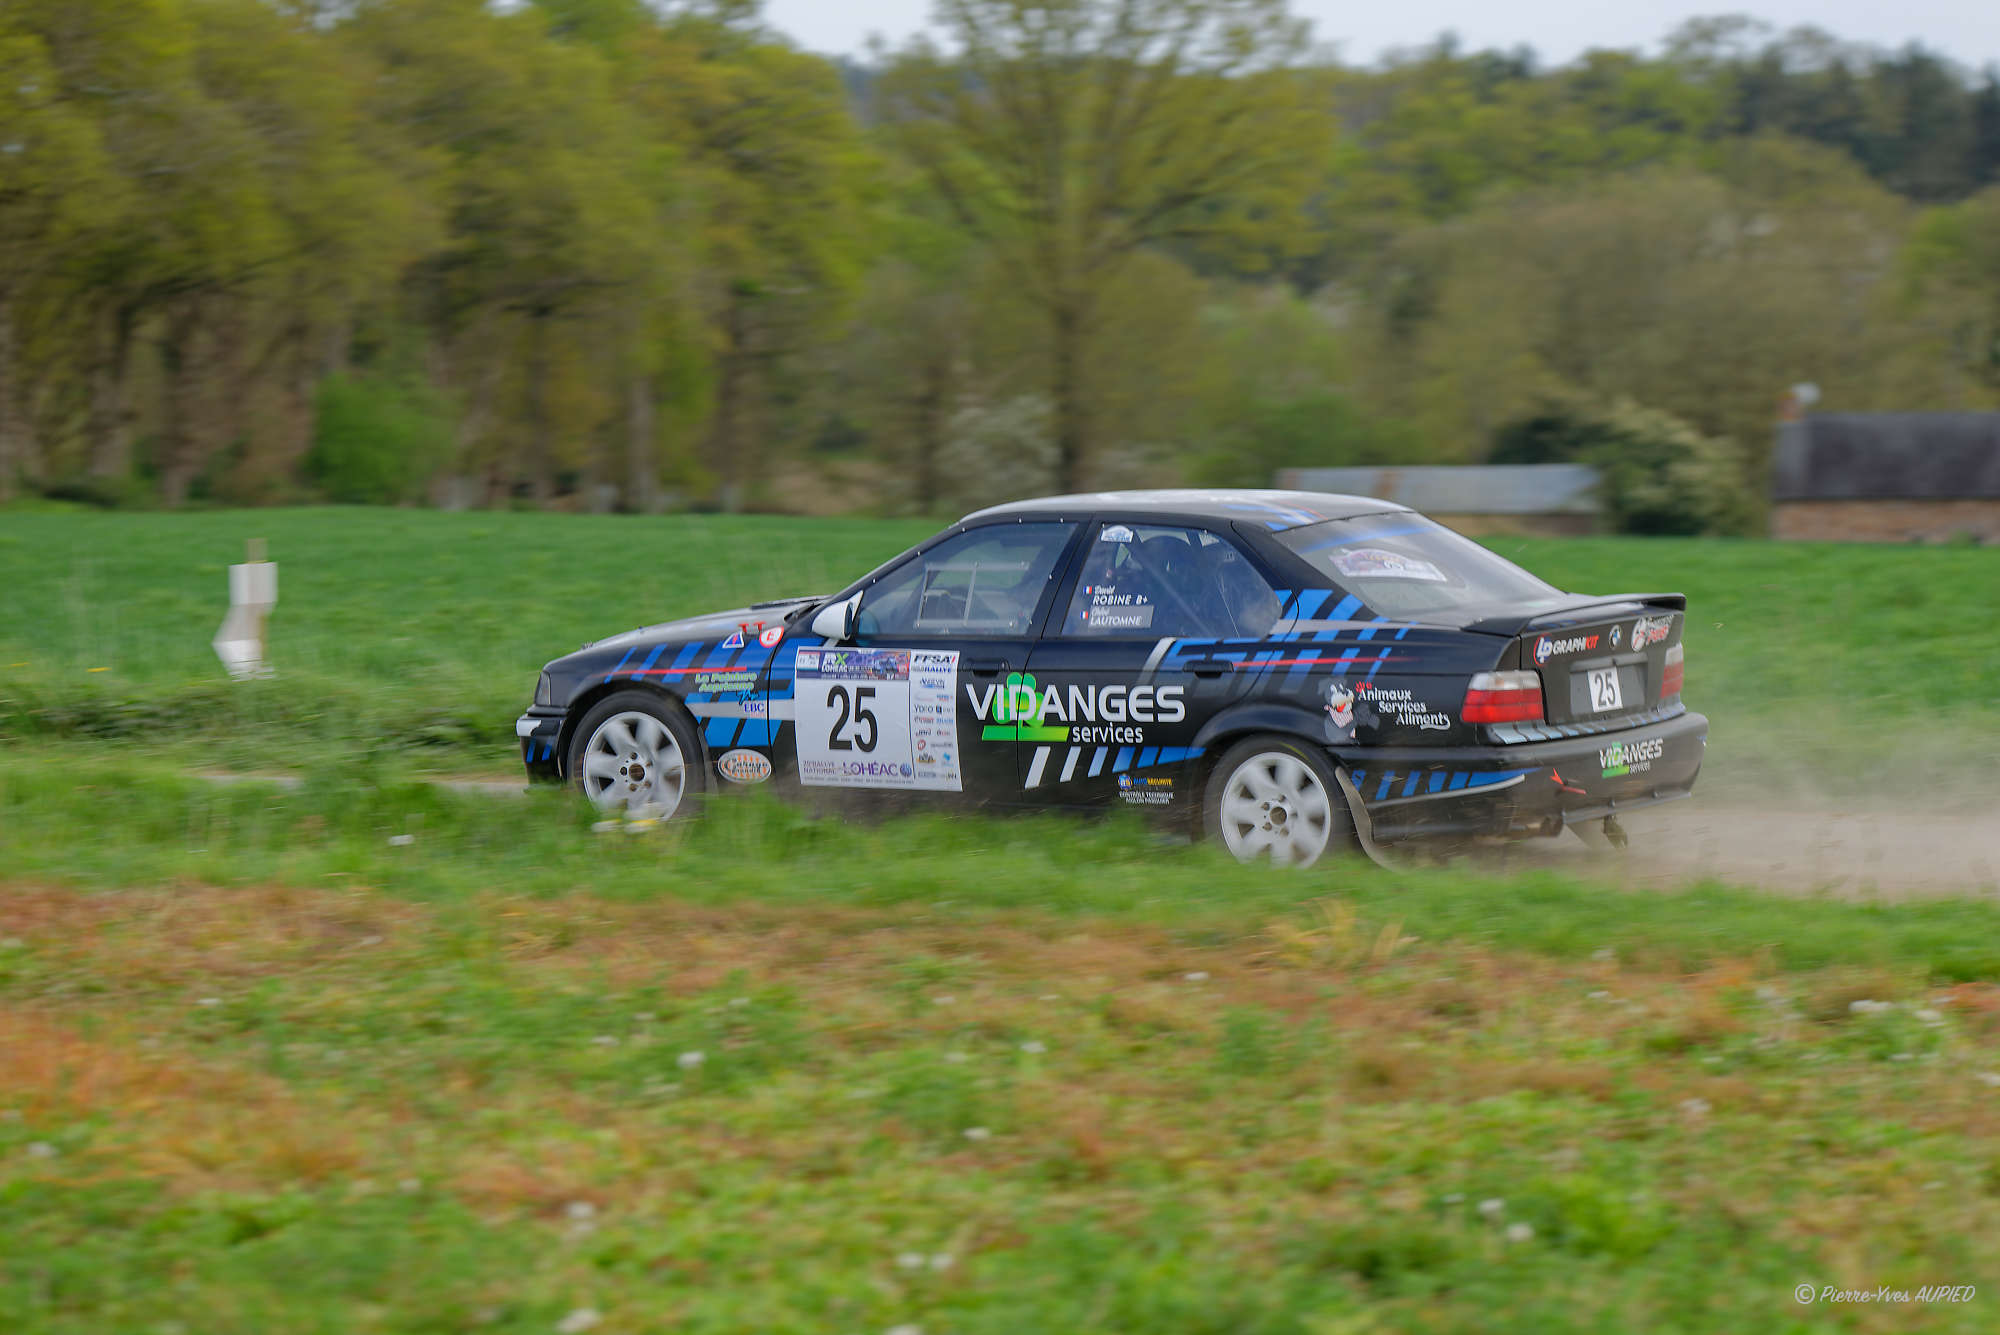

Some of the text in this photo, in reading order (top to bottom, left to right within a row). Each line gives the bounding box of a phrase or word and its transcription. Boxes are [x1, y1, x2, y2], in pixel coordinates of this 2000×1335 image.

[1093, 594, 1132, 606] ROBINE
[1358, 688, 1412, 701] Animaux
[1594, 672, 1616, 706] 25
[965, 683, 1186, 723] VIDANGES
[1378, 700, 1427, 714] Services
[826, 684, 878, 753] 25
[1395, 711, 1451, 730] Aliments
[1072, 721, 1144, 744] services
[1599, 738, 1664, 769] VIDANGES
[842, 760, 899, 777] LOHÉAC
